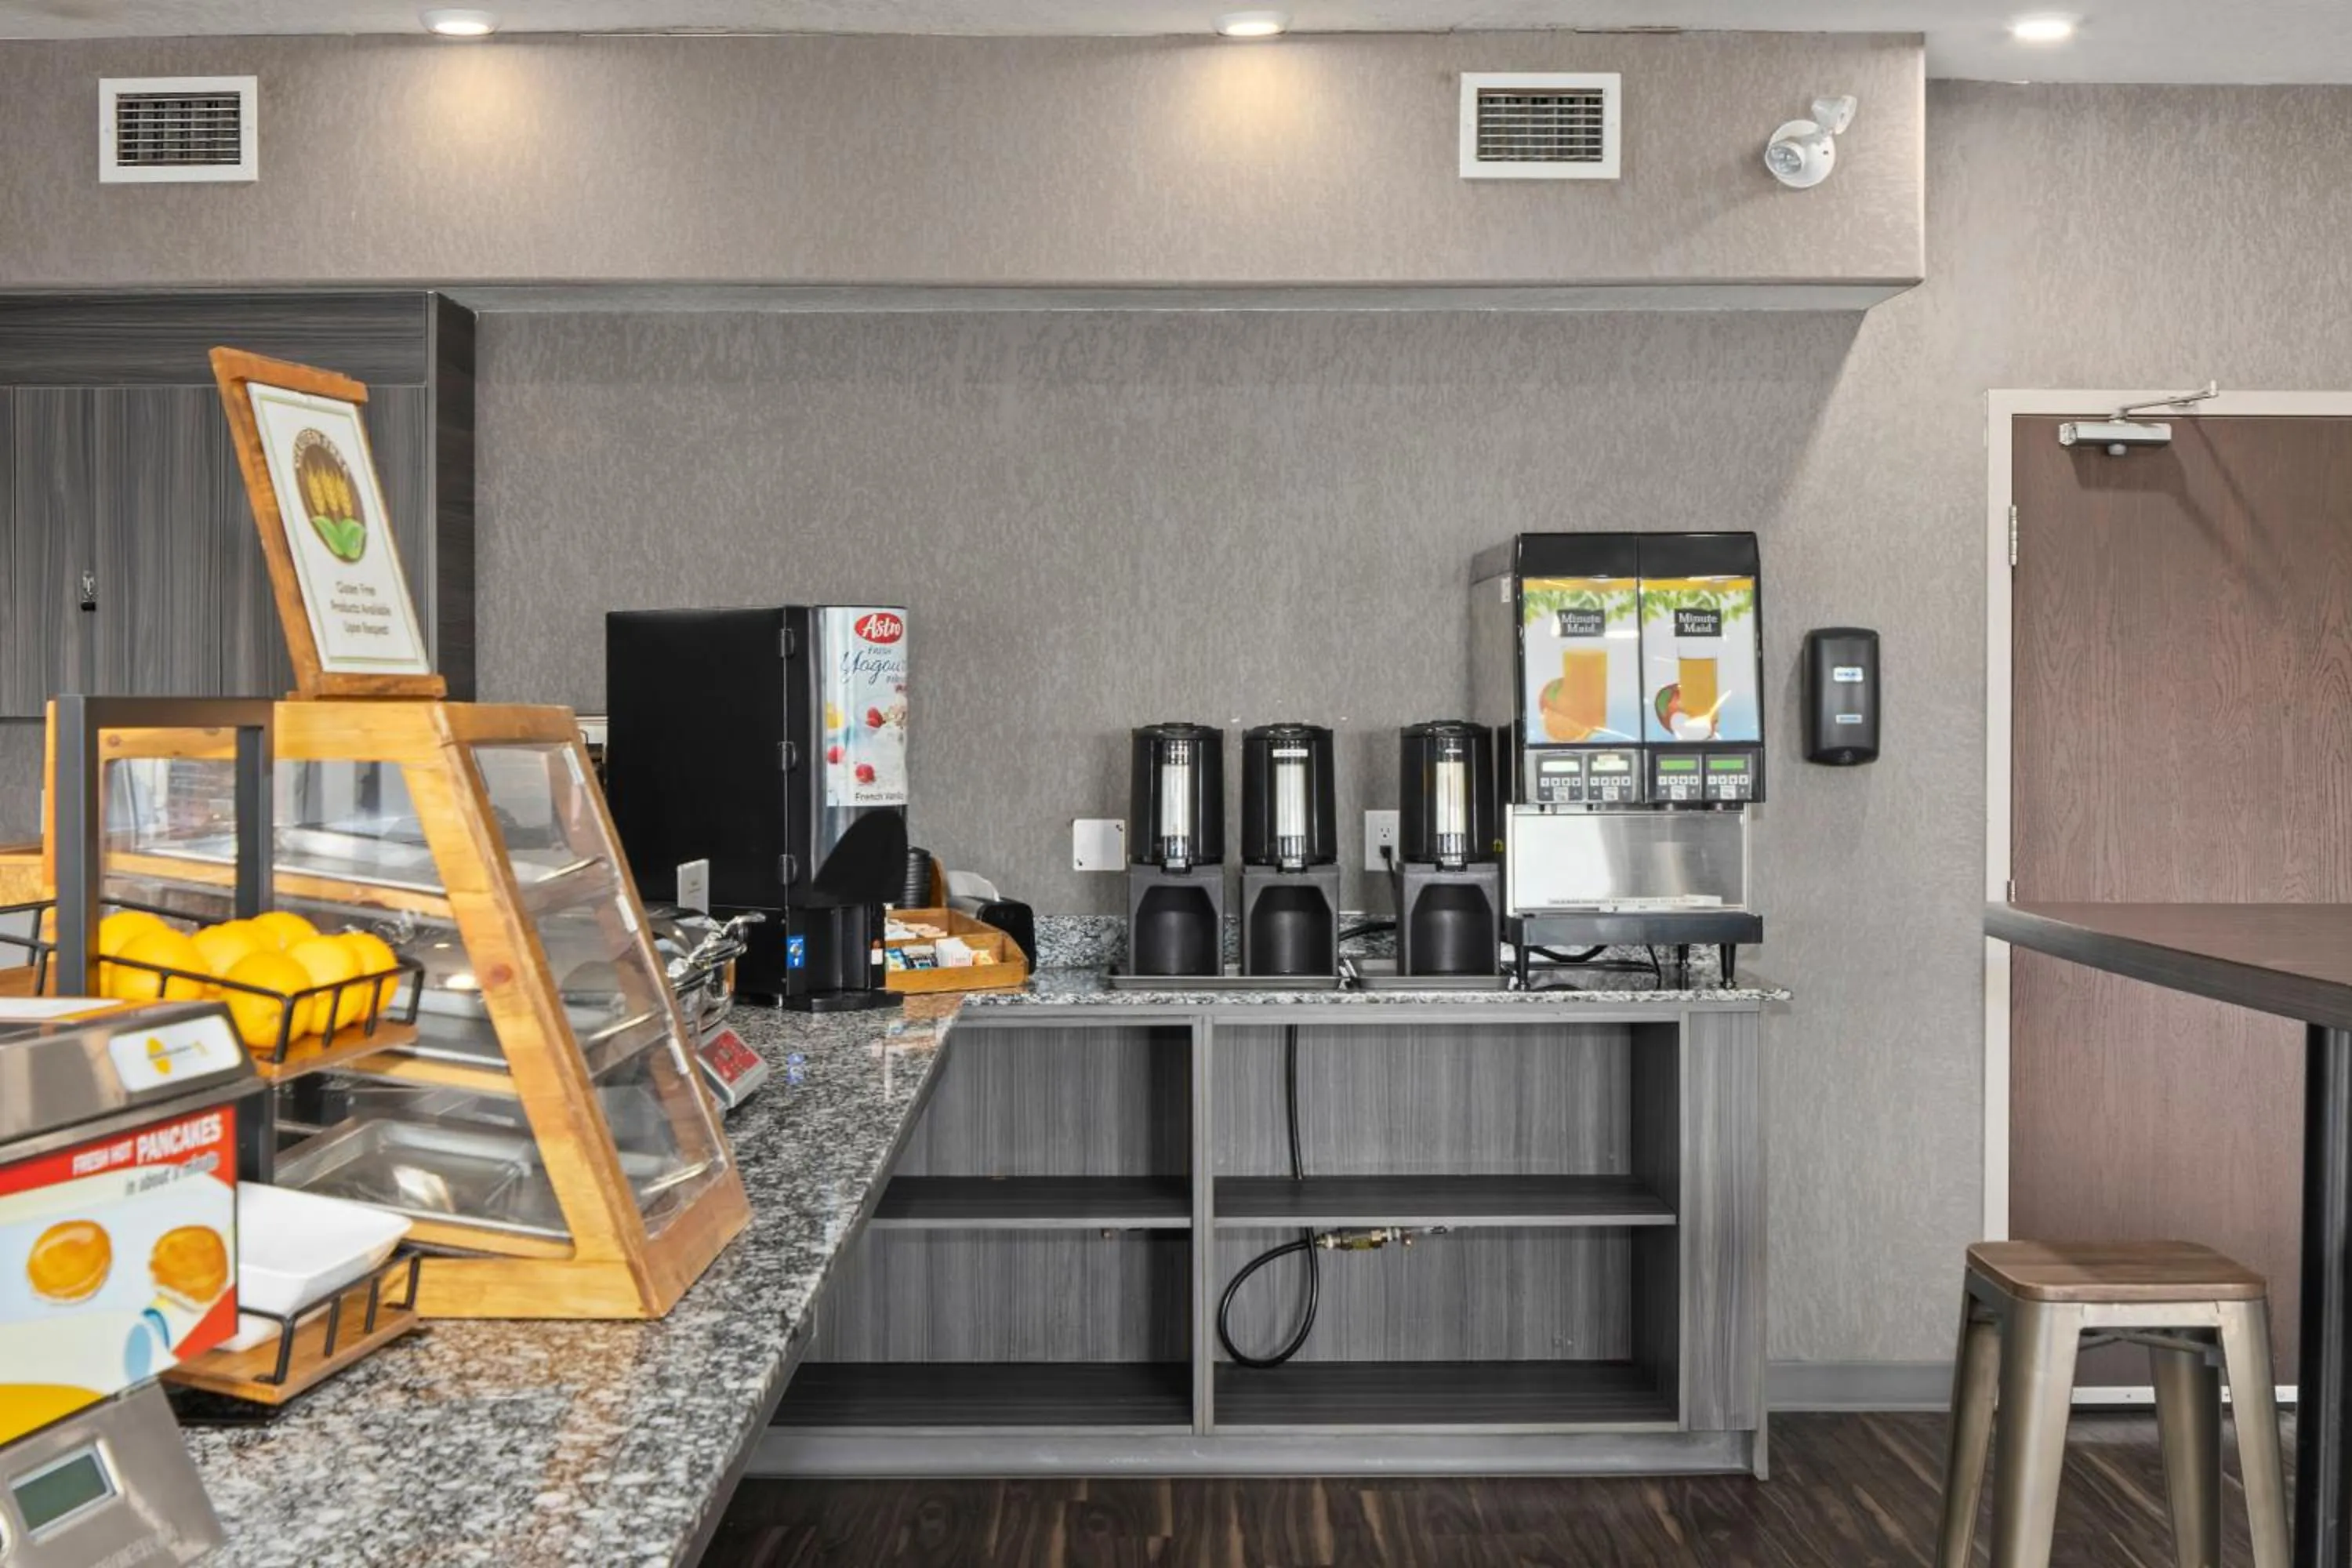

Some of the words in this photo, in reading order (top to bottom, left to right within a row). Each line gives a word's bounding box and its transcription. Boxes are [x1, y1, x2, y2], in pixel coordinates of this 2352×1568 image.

[1562, 614, 1601, 624] Minute
[1679, 613, 1718, 623] Minute
[862, 614, 902, 639] Astro
[1567, 623, 1595, 633] Maid
[1684, 622, 1712, 633] Maid
[110, 1139, 133, 1165] HOT
[136, 1112, 223, 1165] PANCAKES
